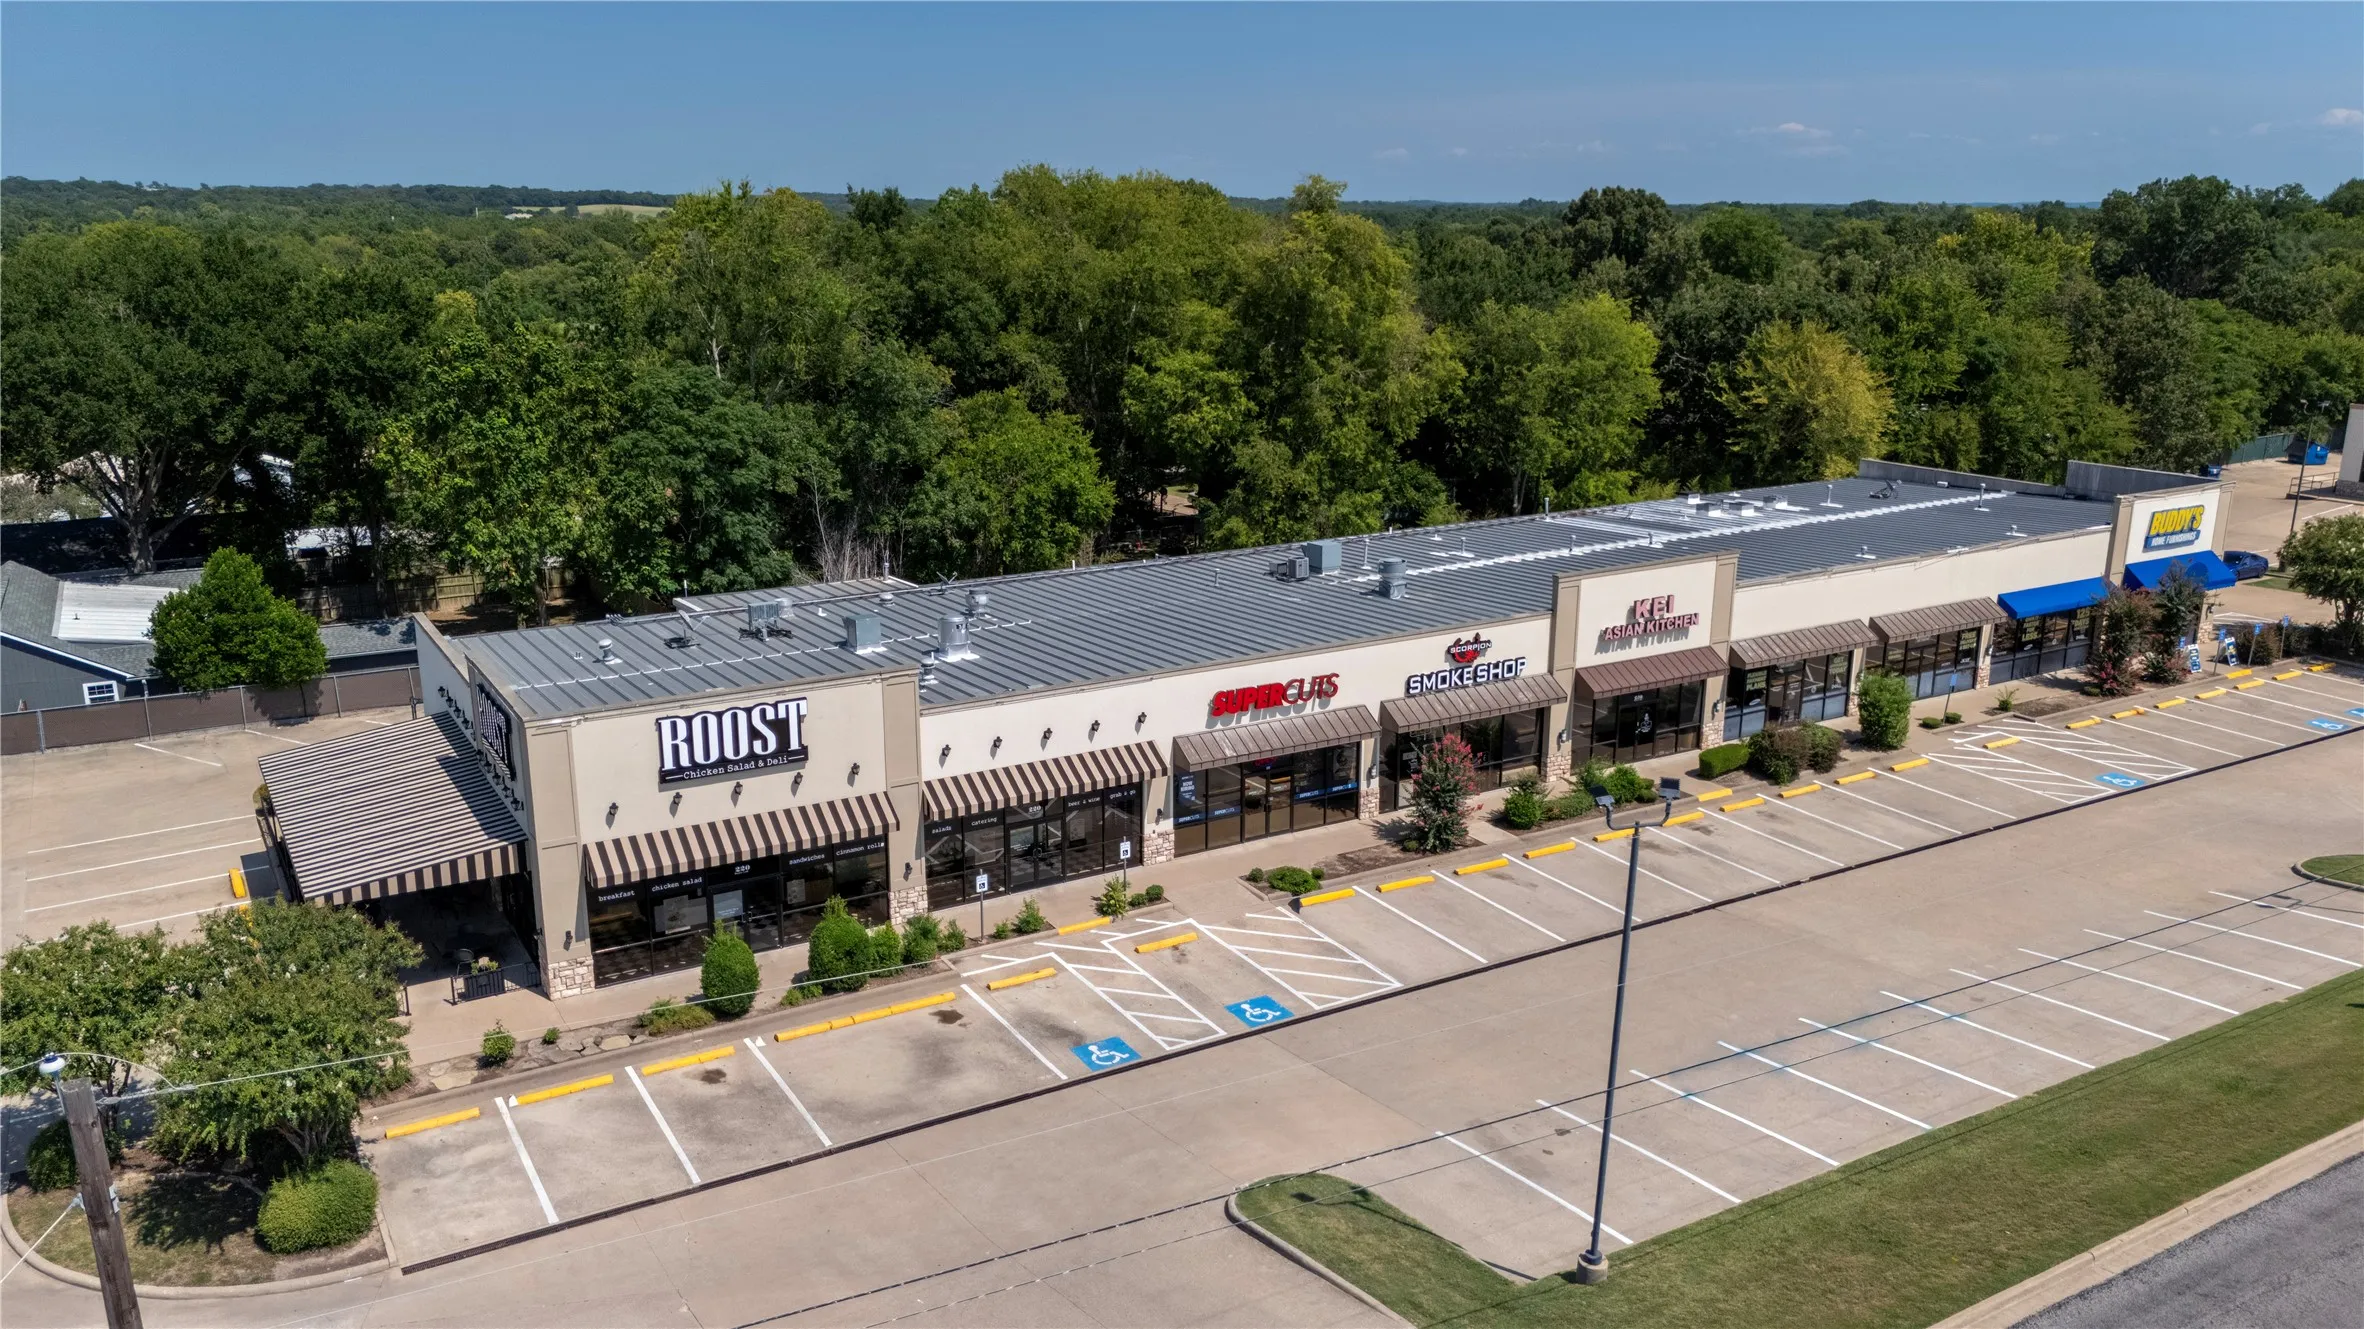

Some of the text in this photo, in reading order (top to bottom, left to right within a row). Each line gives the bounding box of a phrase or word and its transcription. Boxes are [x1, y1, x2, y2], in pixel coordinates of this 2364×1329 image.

[2150, 506, 2205, 536] BUDDY'S
[2151, 531, 2197, 547] HOME FURNISHINGS
[1634, 594, 1675, 619] KEI
[1604, 613, 1700, 641] ASIAN KITCHEN
[1449, 641, 1492, 654] SCORPION
[1408, 658, 1528, 695] SMOKE SHOP
[1211, 672, 1340, 717] SUPERCUTS
[658, 699, 808, 771] ROOST
[683, 769, 725, 779] Chicken
[727, 761, 755, 773] Salad
[767, 755, 788, 765] Deli
[1109, 791, 1122, 799] grab
[971, 816, 998, 826] catering
[931, 825, 952, 834] salads
[788, 853, 825, 865] sandwiches
[835, 846, 865, 856] cinnamon
[734, 864, 750, 873] 220
[651, 876, 703, 892] chicken salad
[598, 889, 636, 902] breakfast
